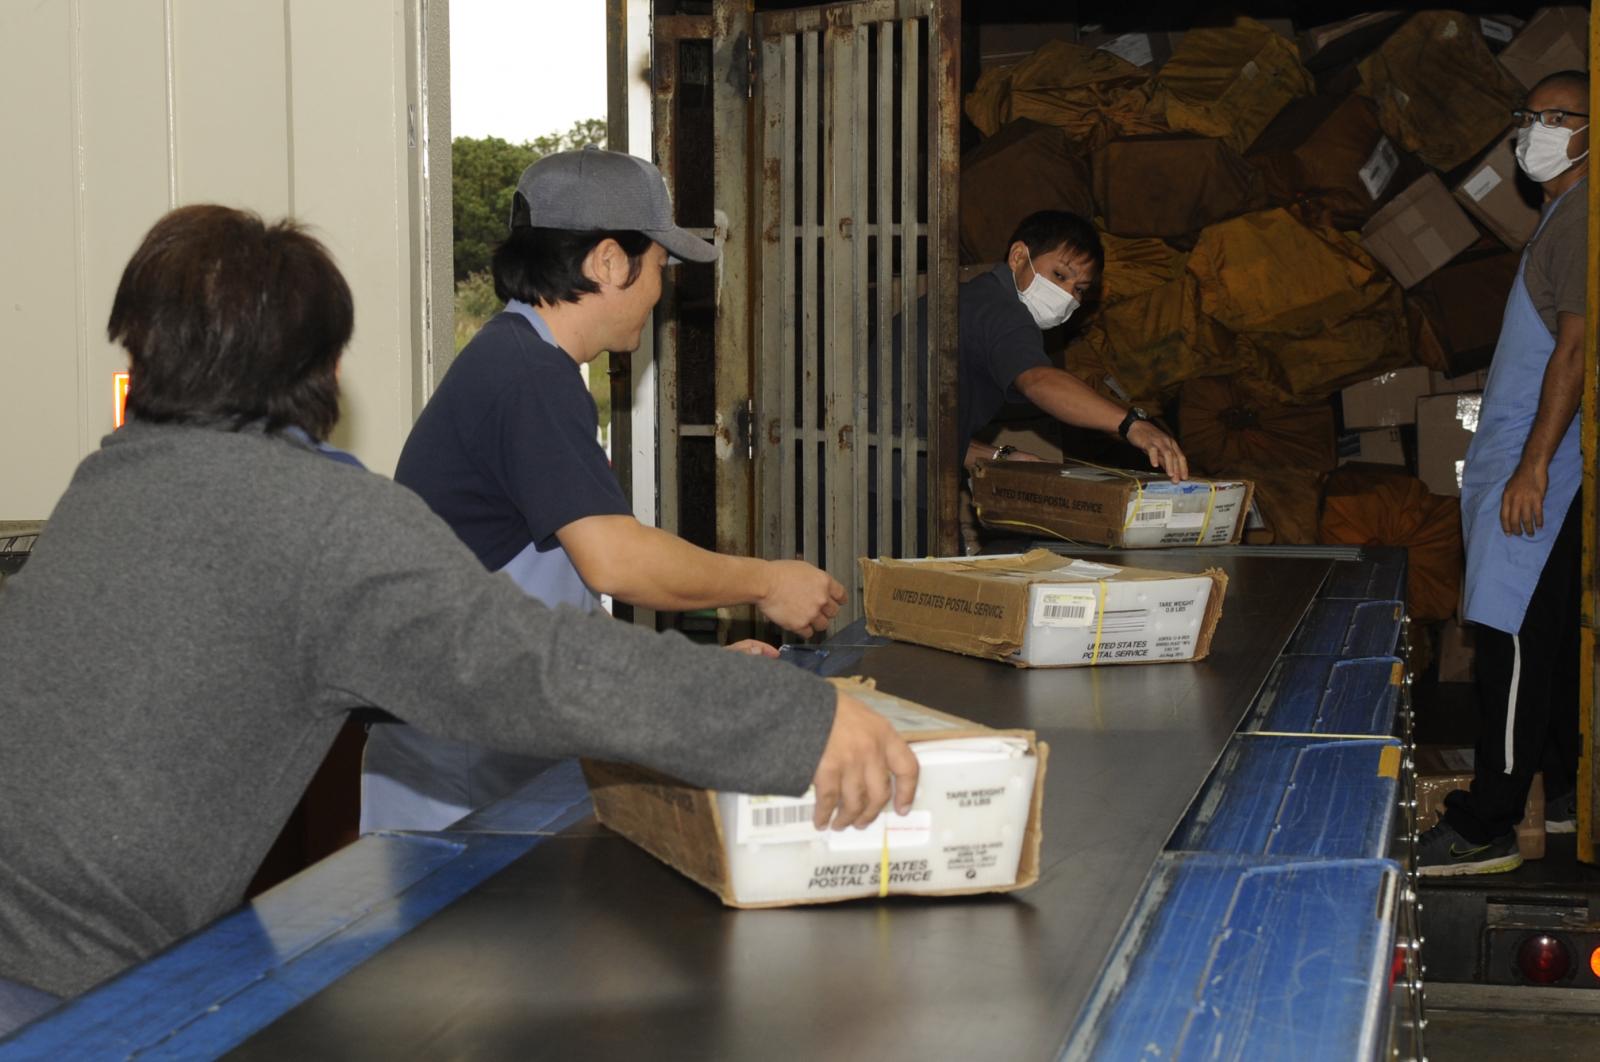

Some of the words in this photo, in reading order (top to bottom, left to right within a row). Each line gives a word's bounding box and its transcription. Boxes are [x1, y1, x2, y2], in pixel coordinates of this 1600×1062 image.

[1043, 495, 1070, 509] POSTAL
[1071, 500, 1104, 513] SERVICE
[892, 588, 919, 605] UNITED
[918, 592, 945, 609] STATES
[944, 597, 973, 615] POSTAL
[973, 602, 1005, 619] SERVICE
[1173, 599, 1194, 607] WEIGHT
[1116, 641, 1148, 649] STATES
[1082, 651, 1112, 659] POTAL
[1115, 649, 1149, 658] SERVICE
[970, 786, 1005, 798] WEIGHT
[813, 863, 870, 877] UNITED
[872, 859, 929, 873] SATES
[808, 876, 865, 889] POSTAL
[868, 870, 933, 885] SRVICE
